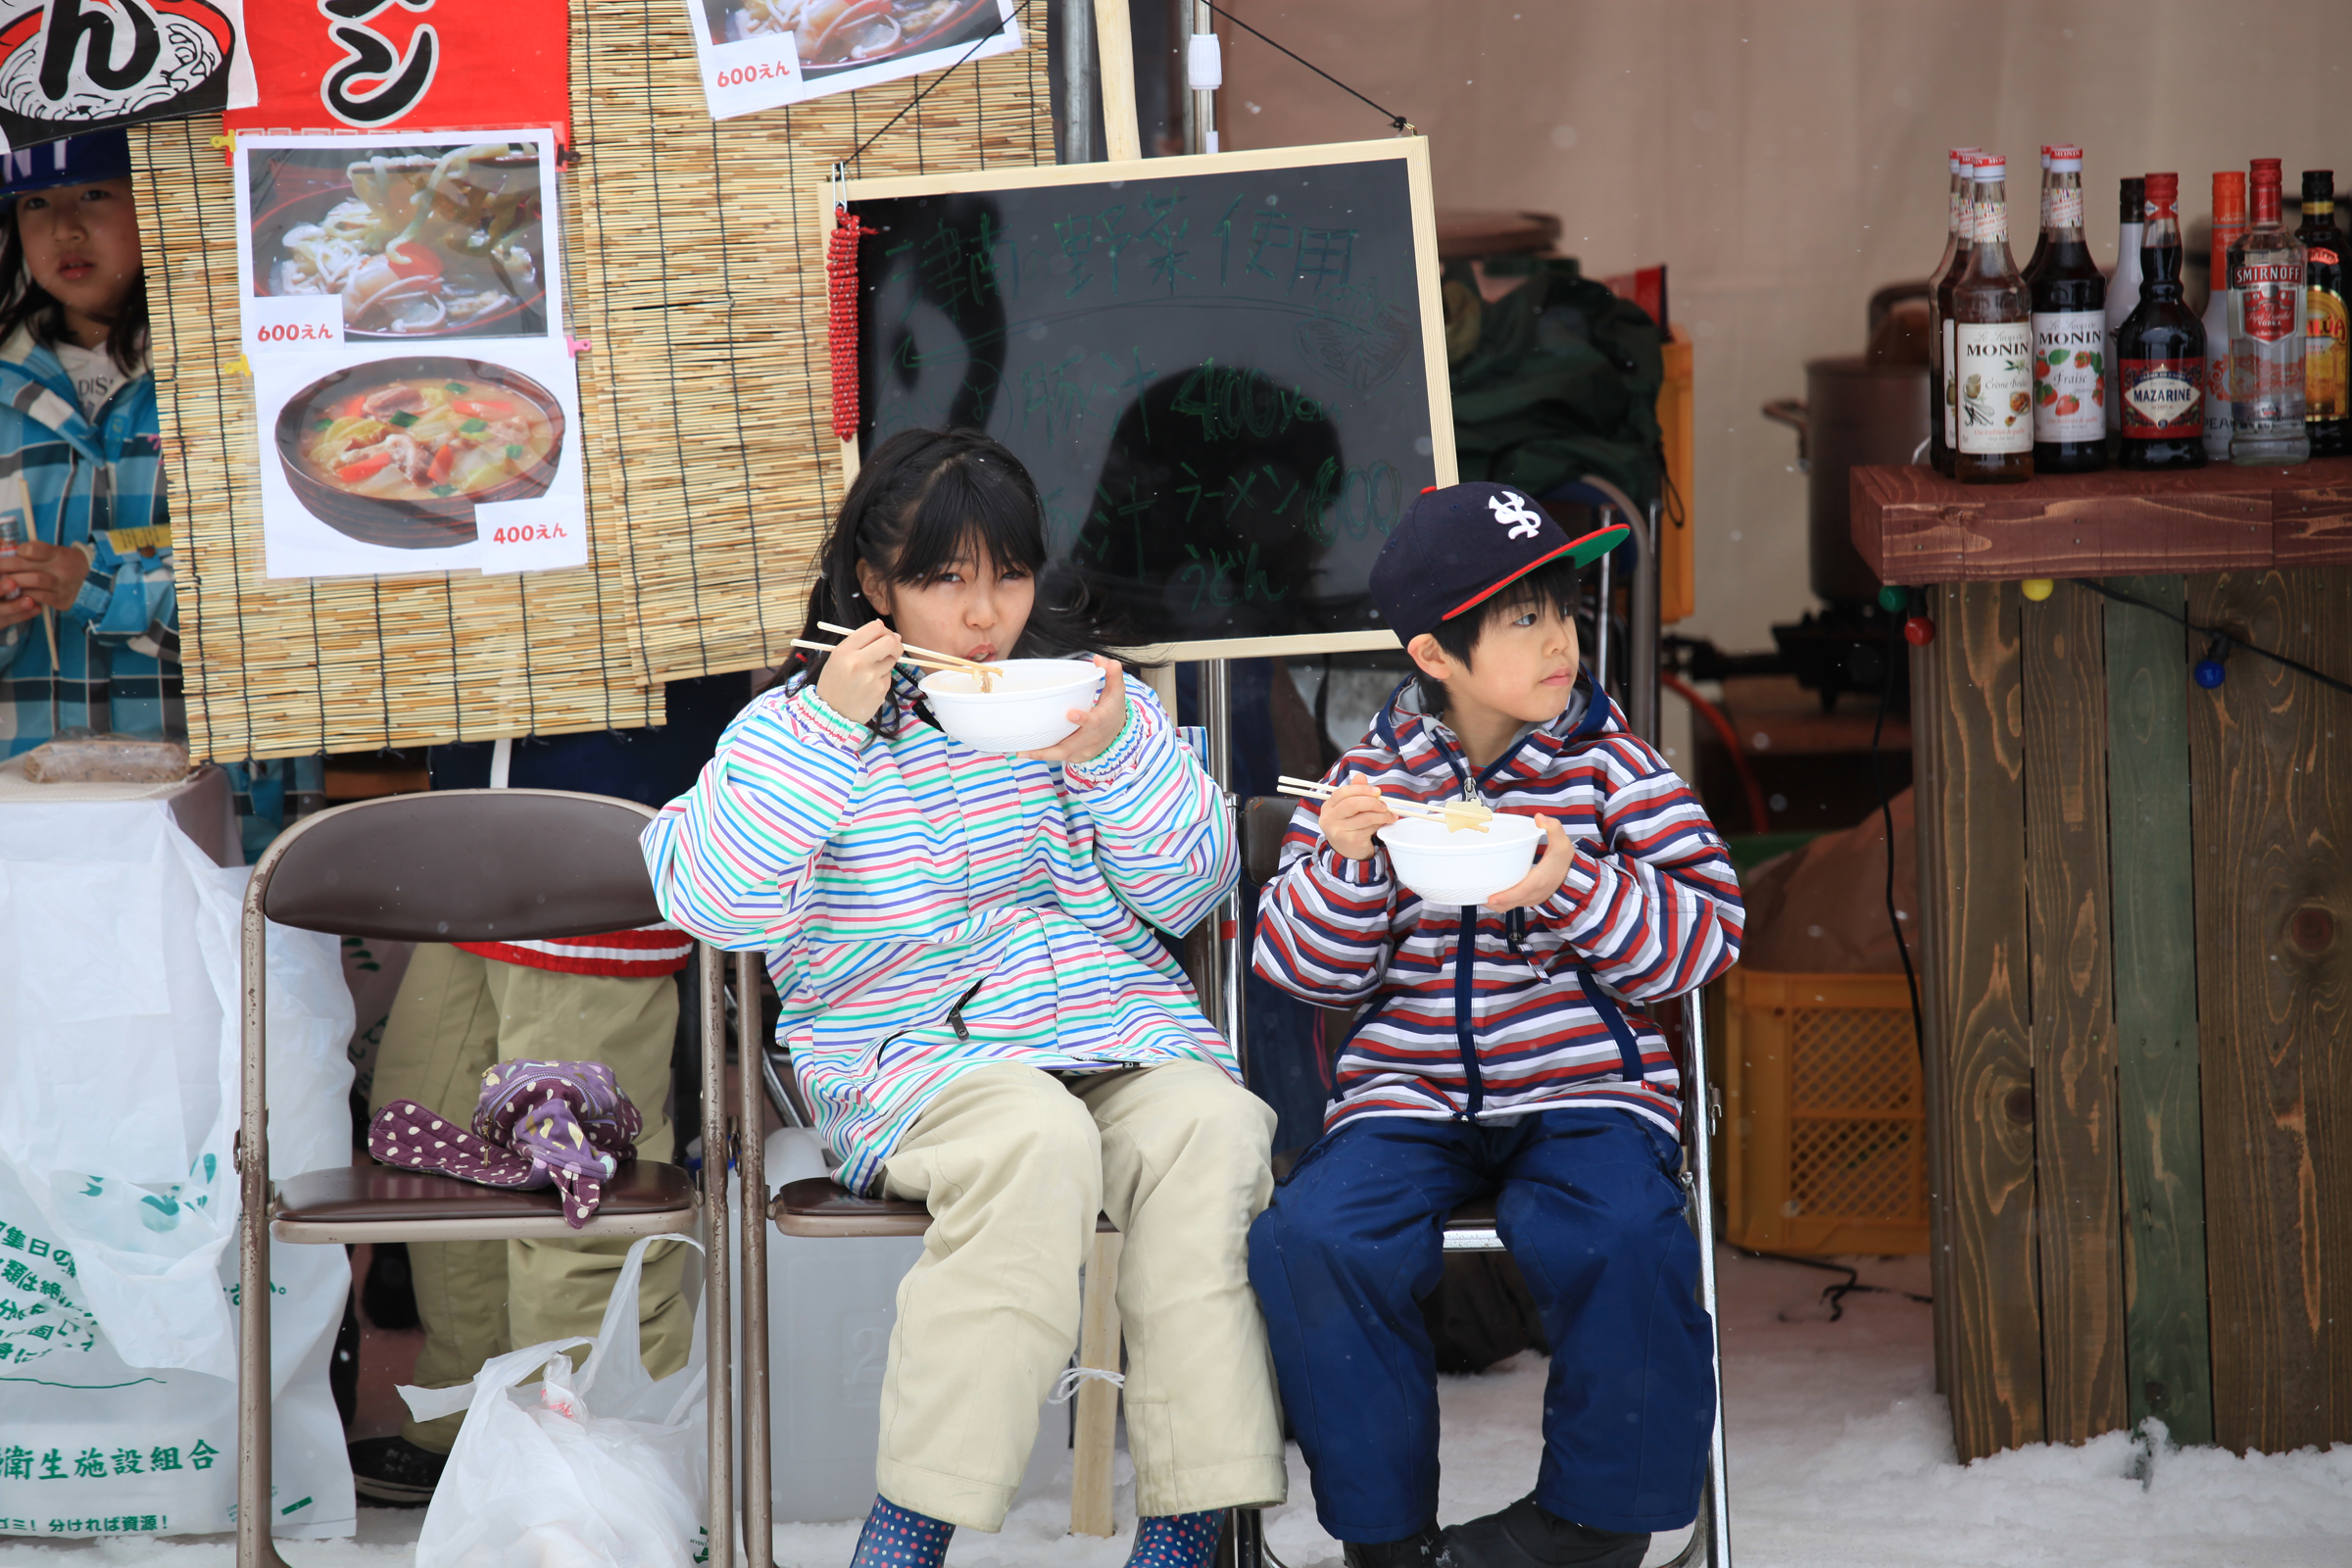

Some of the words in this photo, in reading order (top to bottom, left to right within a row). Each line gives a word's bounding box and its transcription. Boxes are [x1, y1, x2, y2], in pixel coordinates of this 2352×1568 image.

[39, 0, 161, 99] ん
[321, 0, 439, 127] ン
[716, 61, 791, 88] 600えん
[2053, 149, 2081, 158] MONIN
[2236, 266, 2300, 283] SMIRNOFF
[257, 323, 333, 342] 600えん
[2039, 330, 2101, 345] MONIN
[1967, 342, 2029, 357] MONIN
[77, 376, 114, 395] DIS
[2053, 370, 2087, 387] Fraise
[2133, 388, 2191, 403] MAZARINE
[1175, 462, 1300, 529] ラーメン
[493, 522, 567, 544] 400えん
[1182, 541, 1290, 612] うどん
[0, 1221, 76, 1278] 集日の
[0, 1439, 220, 1481] 衛生施設組合
[49, 1514, 169, 1533] 分ければ資源!
